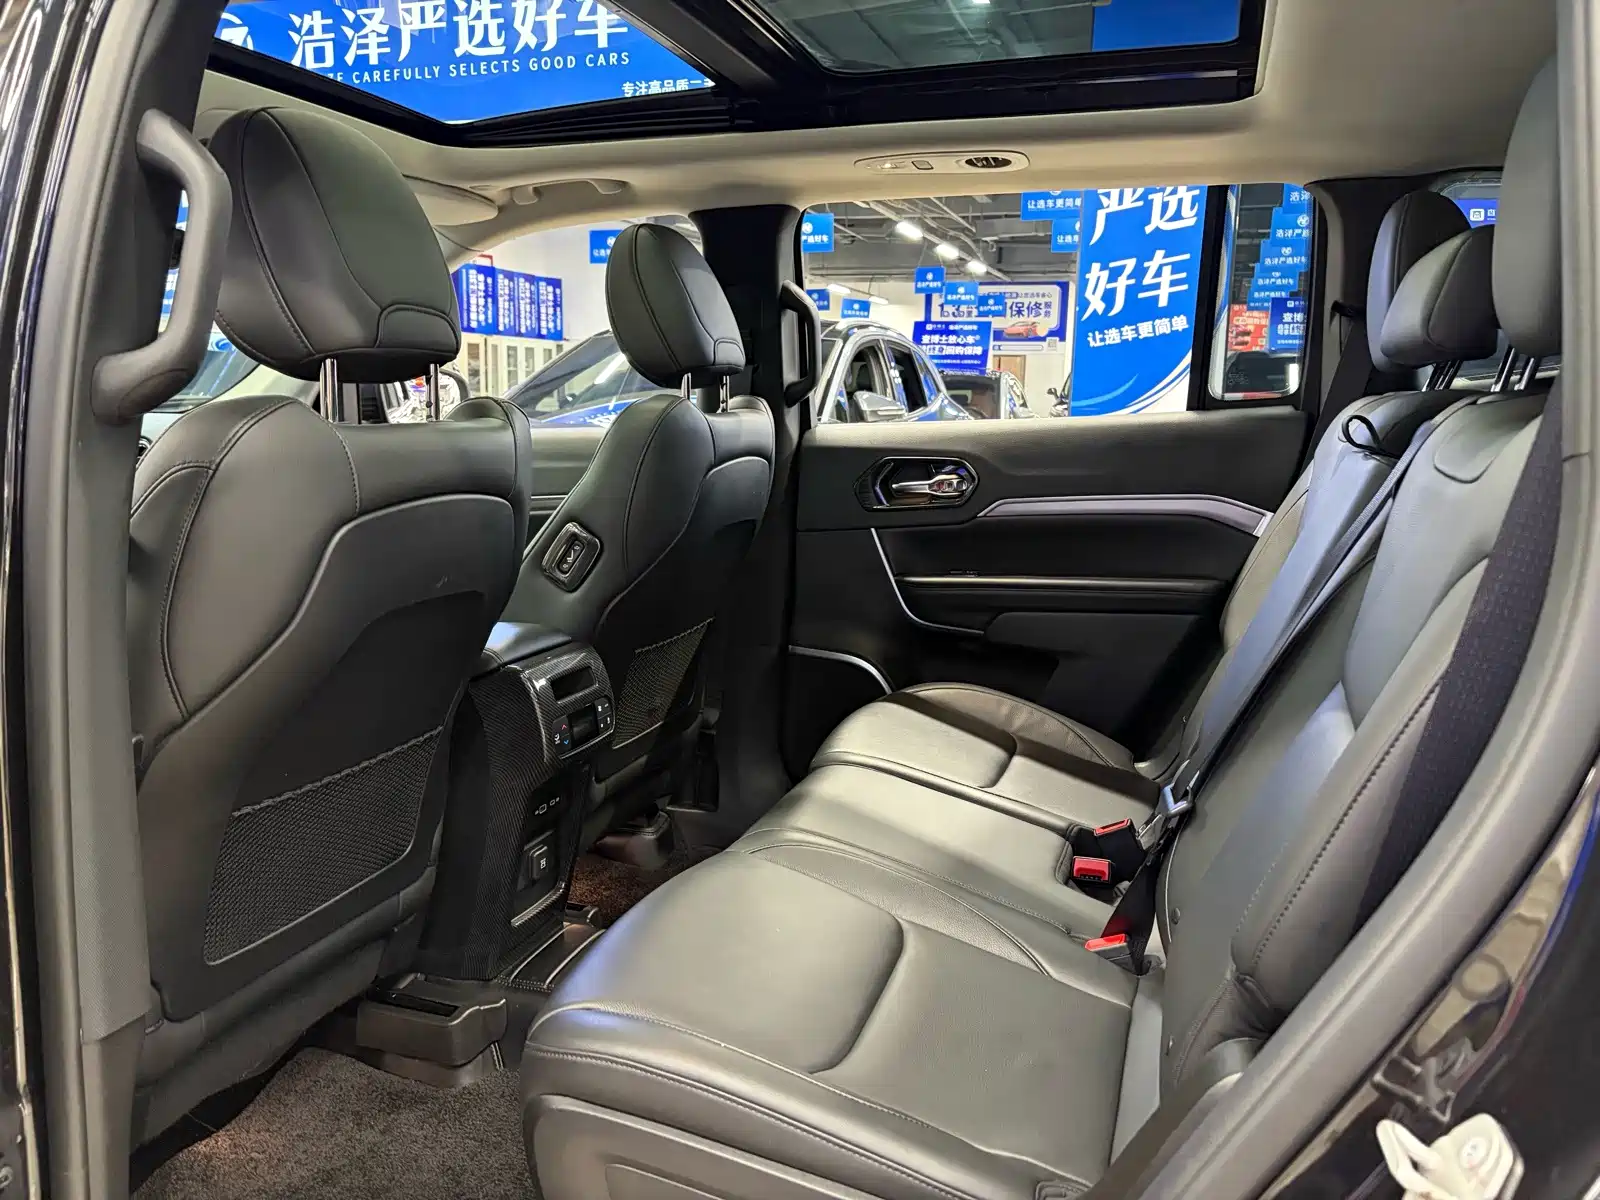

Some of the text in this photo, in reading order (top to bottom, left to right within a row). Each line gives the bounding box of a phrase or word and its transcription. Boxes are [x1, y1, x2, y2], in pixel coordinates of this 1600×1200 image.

[288, 1, 628, 69] 浩泽严选好车
[352, 66, 440, 84] CAREFULLY
[449, 59, 520, 78] SELECTS
[528, 55, 576, 72] GOOD
[585, 52, 630, 67] CARS
[1090, 186, 1200, 245] 严选
[1080, 250, 1191, 321] 好车
[1009, 301, 1042, 318] 保修
[1087, 315, 1189, 348] 让选车更简单
